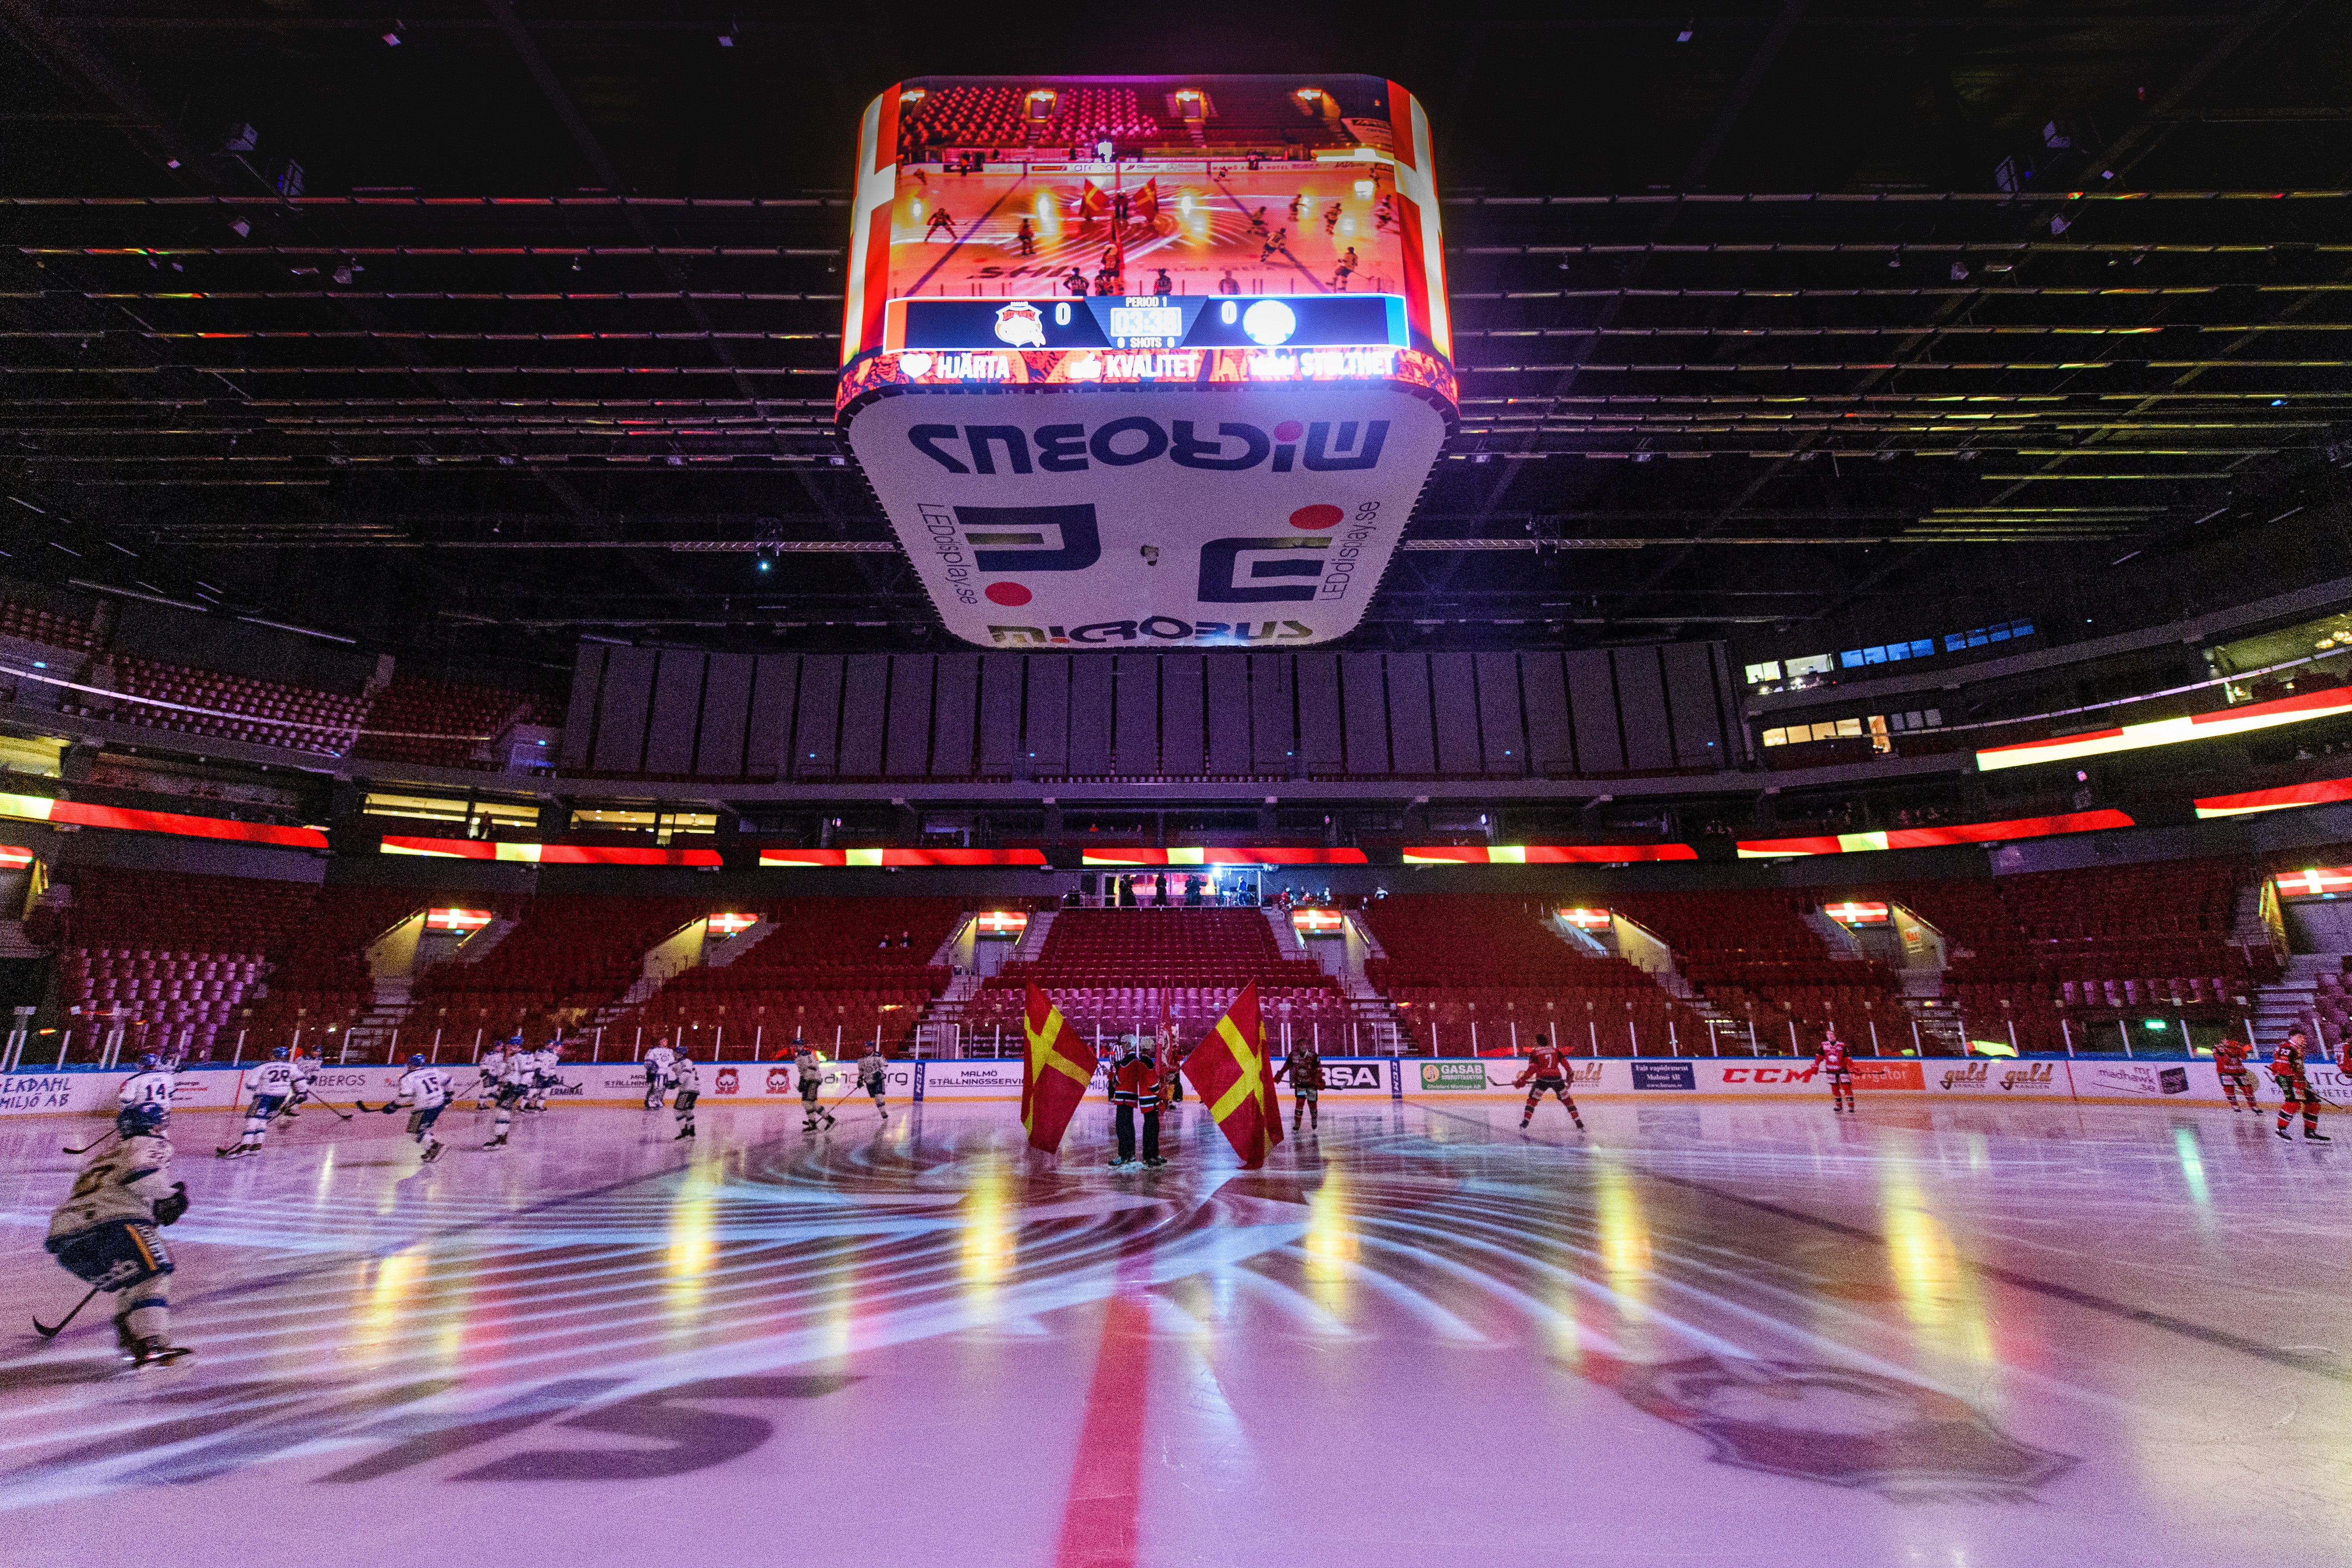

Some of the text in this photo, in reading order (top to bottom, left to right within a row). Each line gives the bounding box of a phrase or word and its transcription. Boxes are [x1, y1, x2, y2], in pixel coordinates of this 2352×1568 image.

[1126, 296, 1167, 307] PERIOD 1
[1055, 302, 1071, 325] 0
[1221, 300, 1237, 324] 0
[1118, 337, 1175, 348] 0 SHOTS 0
[937, 353, 1010, 379] HJÄRTA
[1106, 354, 1198, 379] KVALITET
[1441, 1064, 1482, 1074] GASAB
[1545, 1054, 1552, 1068] 7
[929, 1077, 1024, 1085] STÄLLNINGSSERVI
[1320, 1067, 1378, 1086] RSA
[1721, 1068, 1815, 1083] CCM
[1940, 1062, 1989, 1090] guld
[2000, 1062, 2053, 1091] guld
[4, 1077, 72, 1093] EKDAHL
[145, 1083, 166, 1102] 14
[44, 1093, 70, 1107] AB
